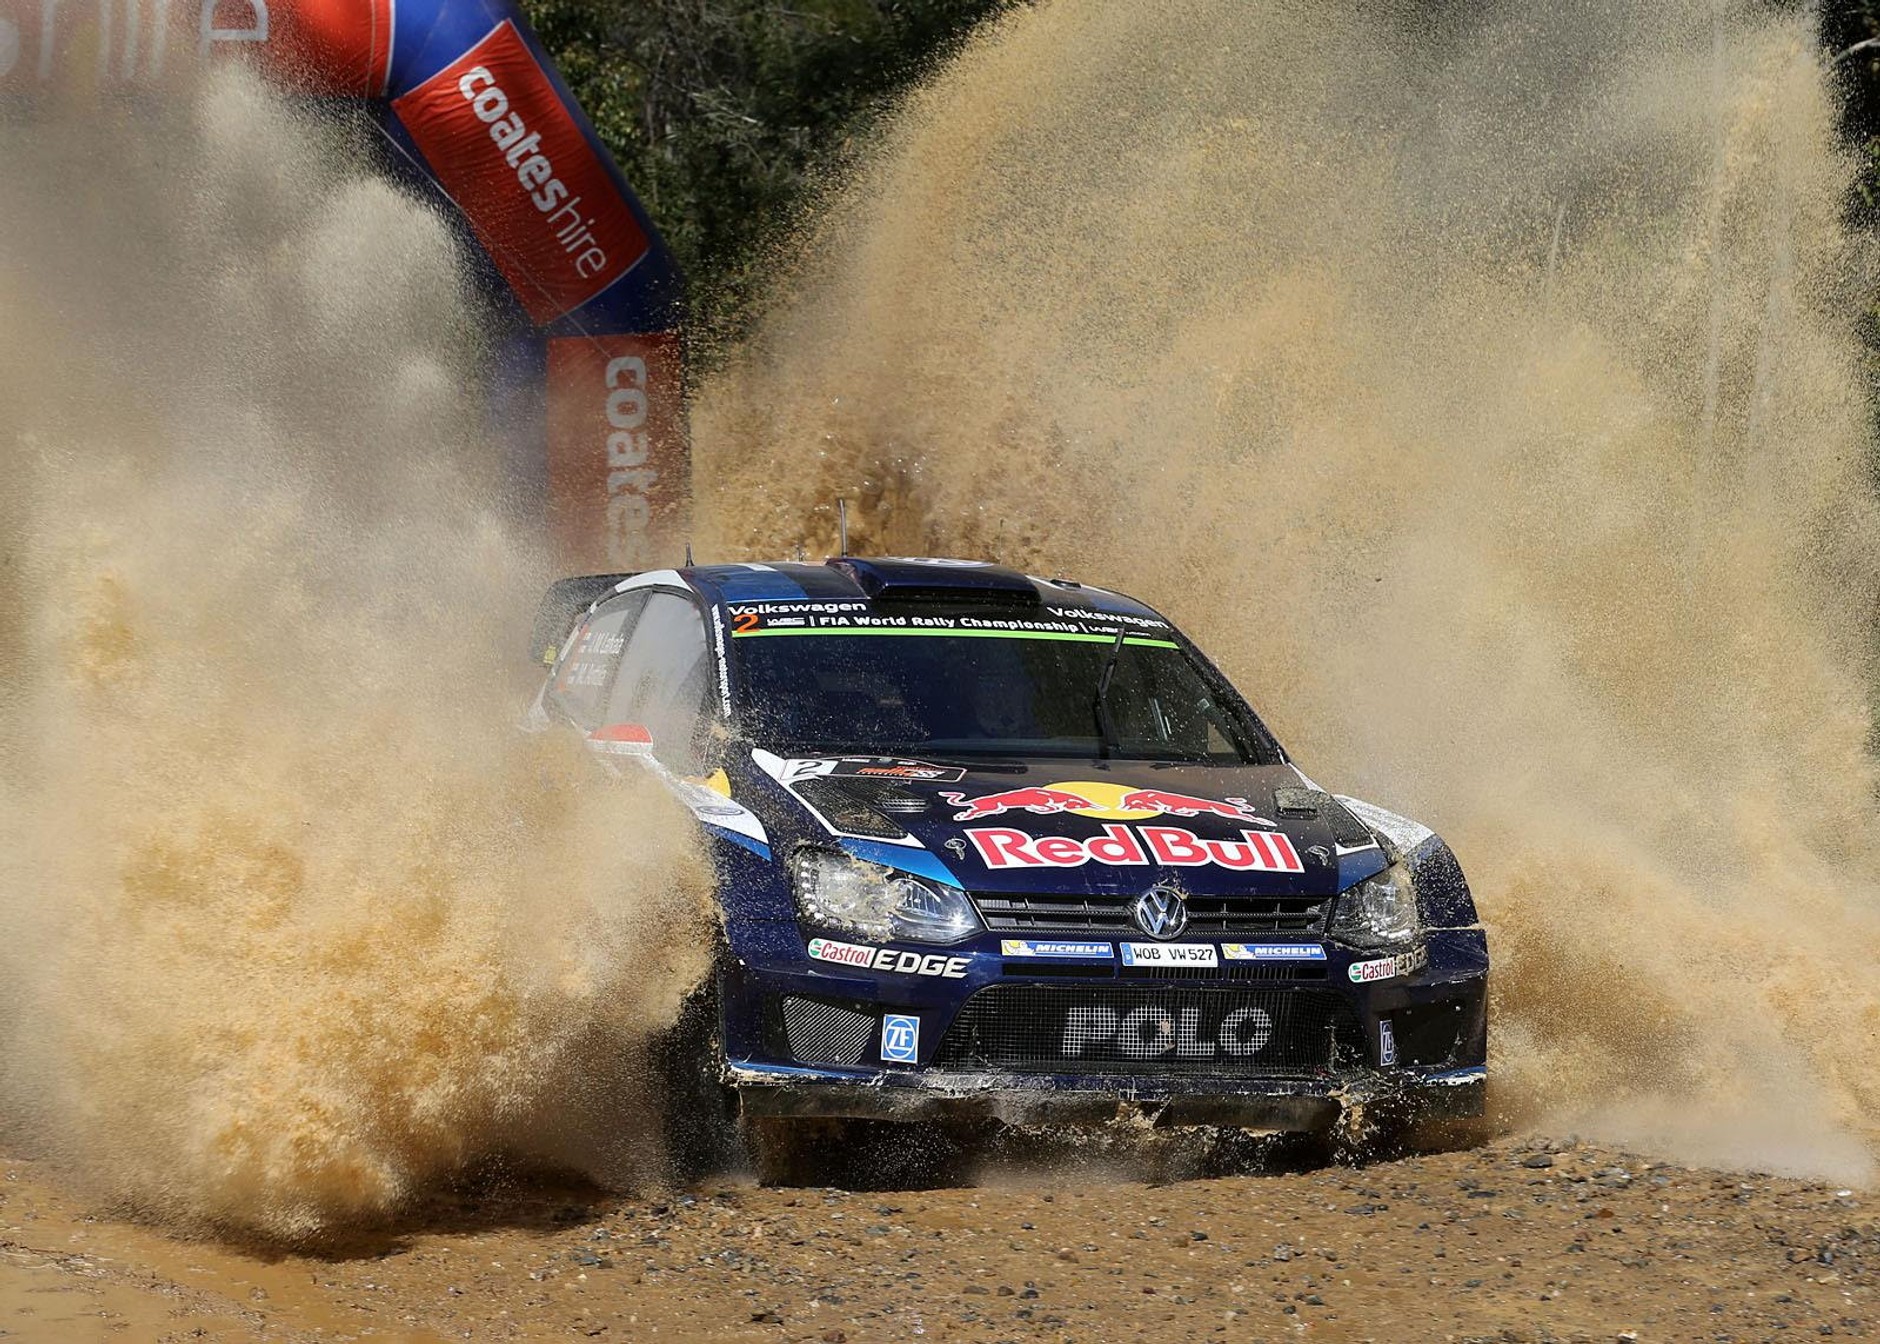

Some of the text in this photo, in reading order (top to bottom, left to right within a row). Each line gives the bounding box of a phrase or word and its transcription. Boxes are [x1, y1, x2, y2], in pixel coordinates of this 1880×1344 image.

[727, 603, 867, 616] Volkswagen
[1046, 606, 1170, 629] Volkswagen
[733, 613, 761, 633] 2
[819, 616, 850, 626] FIA
[853, 616, 907, 626] World
[911, 617, 955, 628] Rally
[960, 617, 1079, 633] Championship
[793, 761, 823, 777] 2
[963, 824, 1305, 873] Red Bull
[1035, 944, 1110, 953] MICHELIN
[1133, 947, 1214, 961] WOB VW 527
[1254, 947, 1321, 955] MICHELIN
[820, 942, 973, 979] Castrol EDGE
[1362, 960, 1394, 980] Castrol
[888, 1026, 912, 1050] ZF
[1062, 1006, 1272, 1060] POLO
